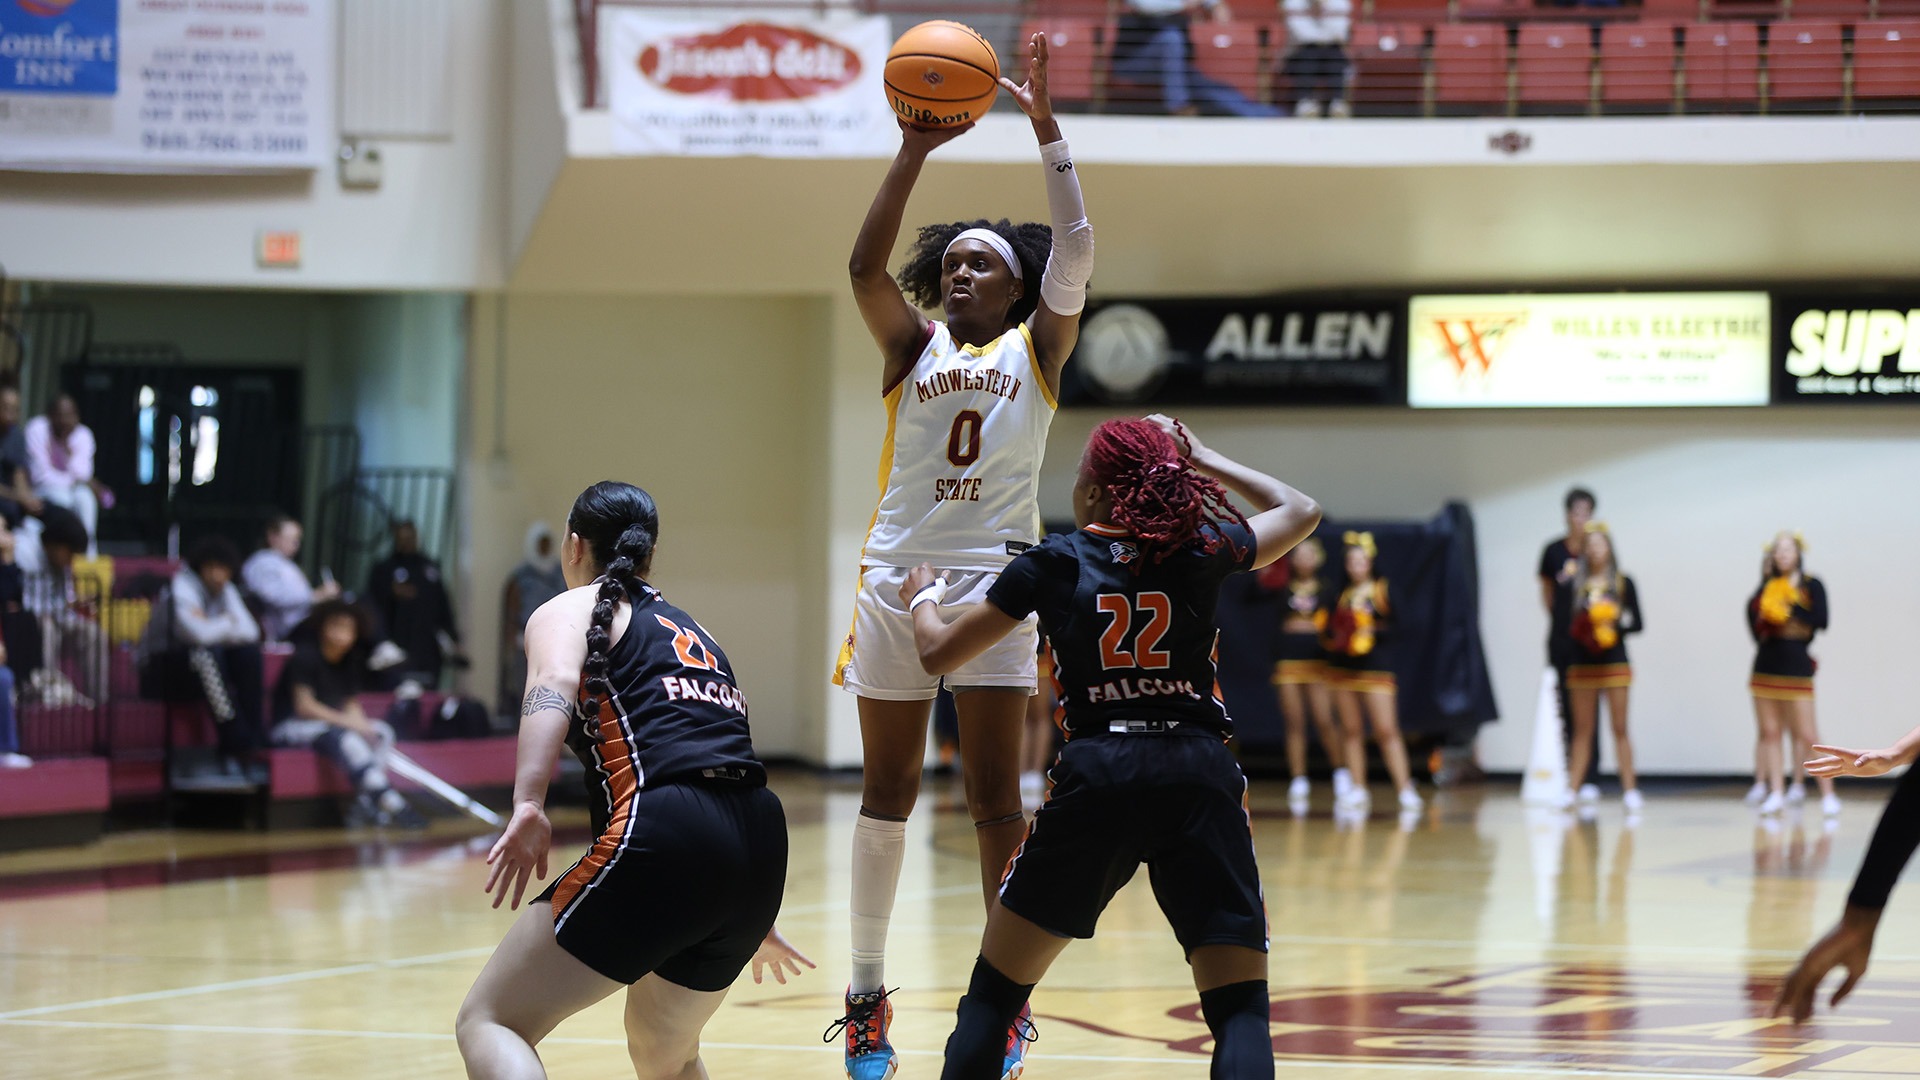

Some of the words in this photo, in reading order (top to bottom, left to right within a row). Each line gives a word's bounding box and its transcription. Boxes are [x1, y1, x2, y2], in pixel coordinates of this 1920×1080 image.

[894, 95, 970, 125] Wilson
[1204, 312, 1393, 362] ALLEN
[1651, 317, 1762, 339] ELECTRIC
[916, 368, 1021, 403] MIDWESTERN
[946, 409, 984, 468] 0
[935, 478, 982, 502] STATE
[1096, 590, 1172, 671] 22
